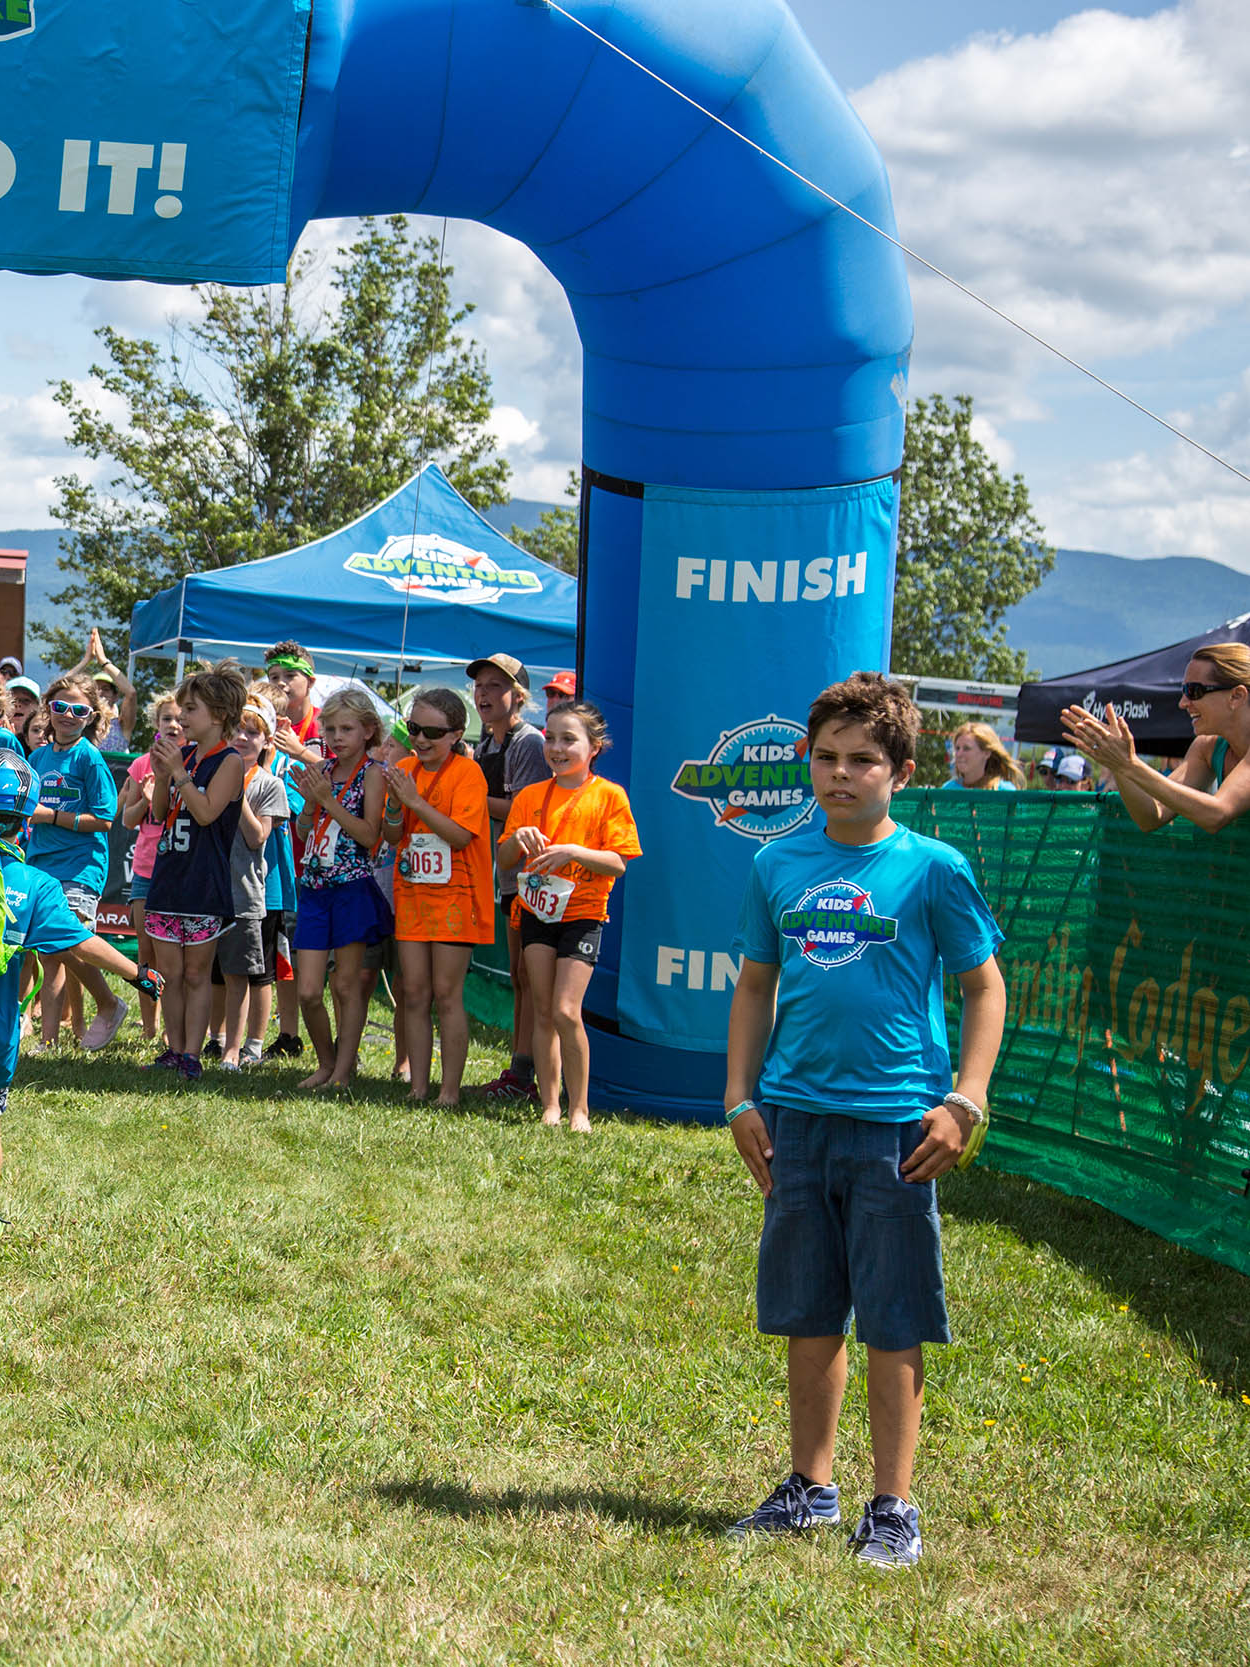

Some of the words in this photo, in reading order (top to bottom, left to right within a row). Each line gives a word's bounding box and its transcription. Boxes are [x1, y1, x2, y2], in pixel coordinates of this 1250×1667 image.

[58, 139, 187, 219] IT!
[412, 549, 466, 567] KIDS
[350, 556, 539, 587] ADVENTURE
[402, 574, 483, 588] GAMES
[676, 551, 867, 602] FINISH
[1093, 701, 1122, 722] Hyro
[1123, 700, 1149, 718] Flask
[743, 745, 805, 762] KIDS
[677, 764, 812, 787] ADVENTU
[728, 789, 803, 806] GAMES
[817, 898, 853, 911] KIDS
[782, 911, 896, 937] ADVENTURE
[807, 930, 855, 944] GAMES
[656, 945, 745, 991] FIN
